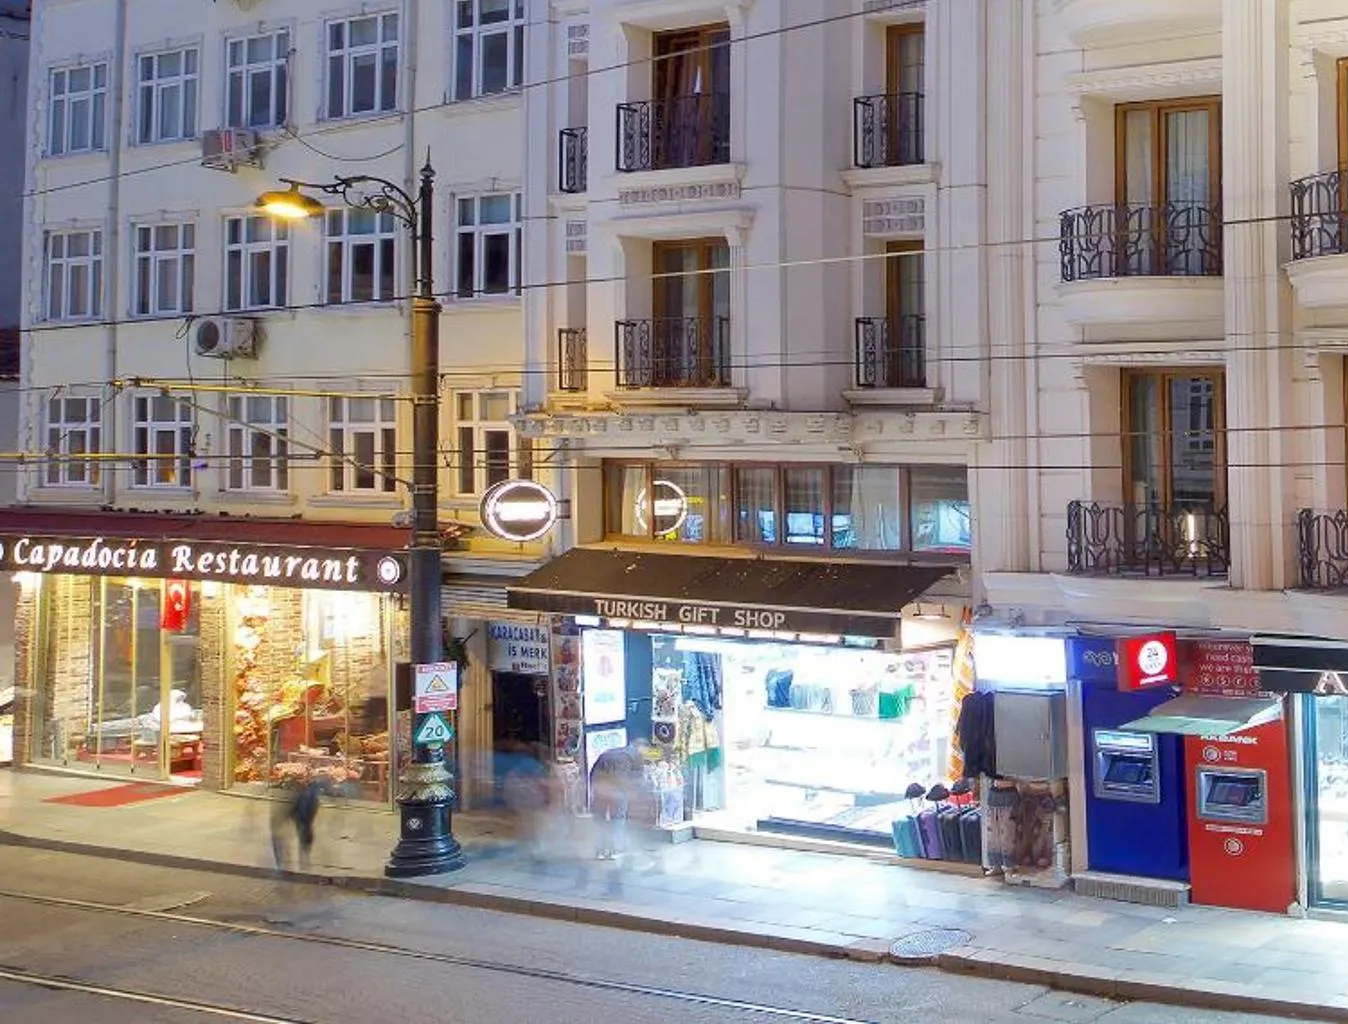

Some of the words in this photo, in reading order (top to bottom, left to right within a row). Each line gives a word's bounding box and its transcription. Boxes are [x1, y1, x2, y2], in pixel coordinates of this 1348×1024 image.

[14, 538, 157, 570] Capadocia
[172, 545, 358, 583] Restaurant
[594, 599, 667, 620] TURKISH
[679, 606, 720, 624] GIFT
[734, 610, 785, 628] SHOP
[425, 726, 444, 738] 20
